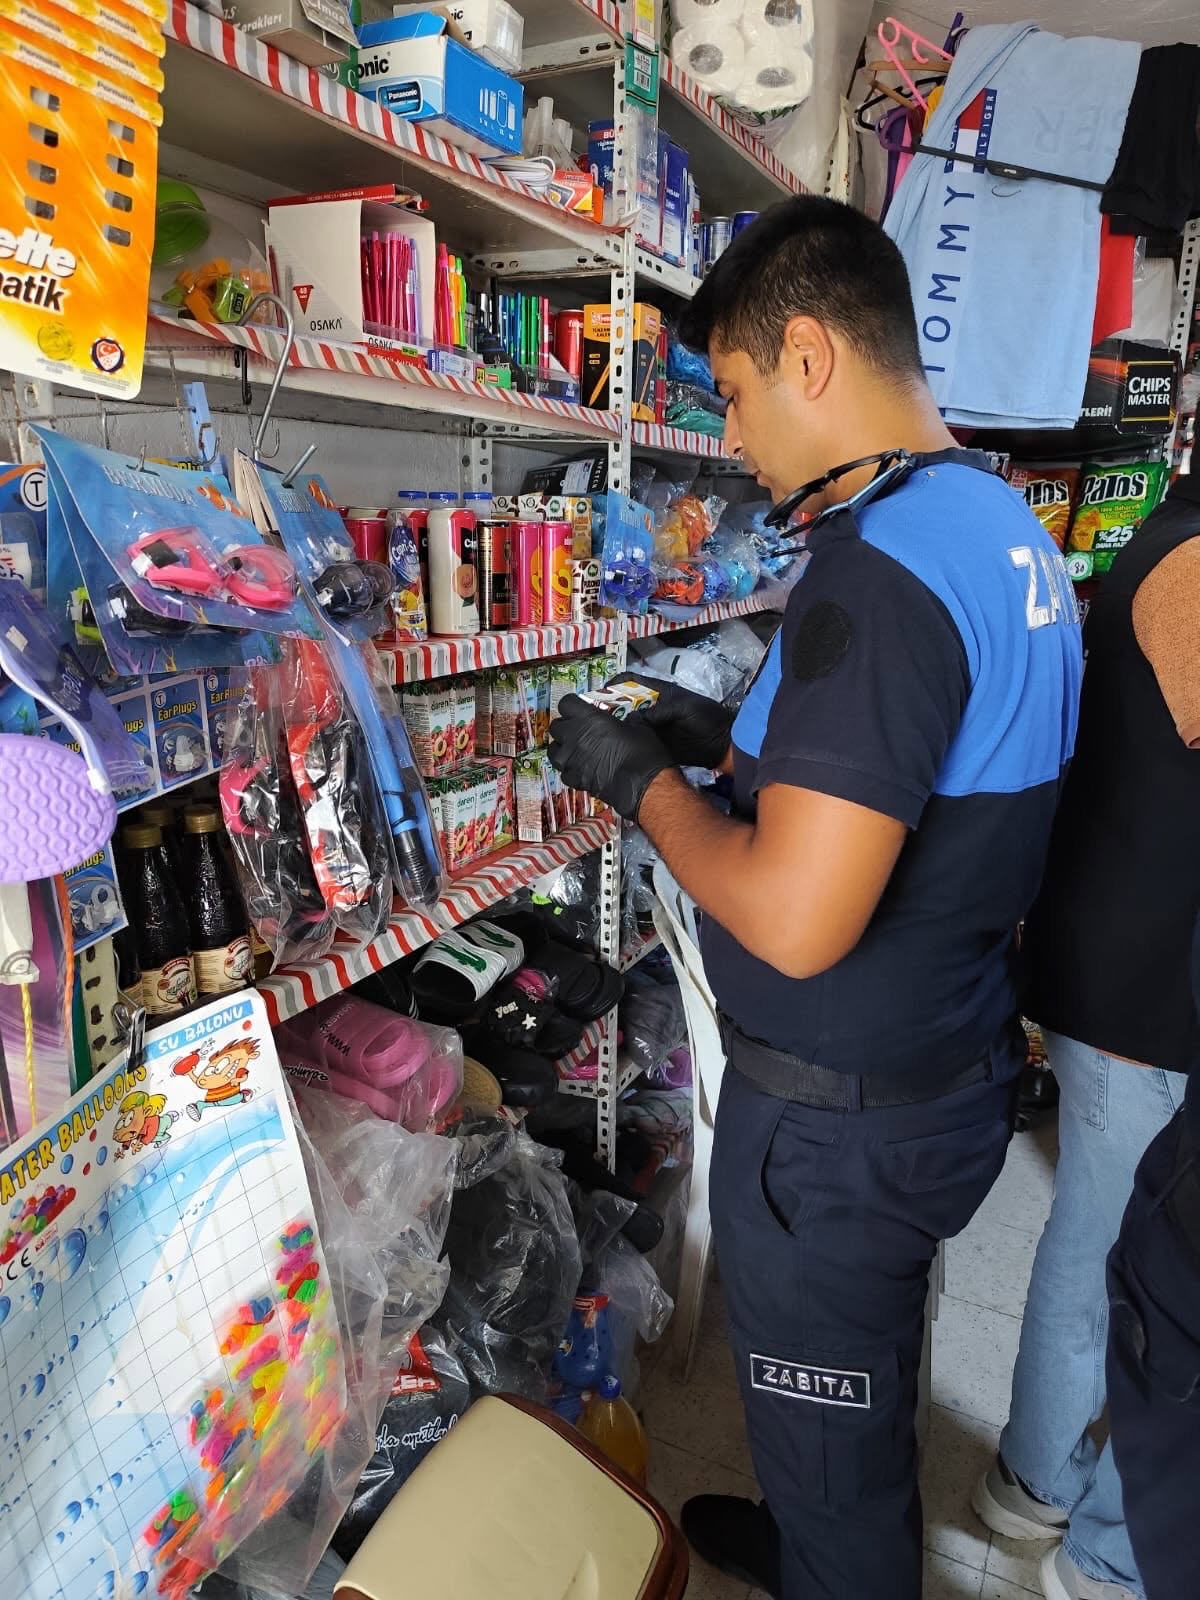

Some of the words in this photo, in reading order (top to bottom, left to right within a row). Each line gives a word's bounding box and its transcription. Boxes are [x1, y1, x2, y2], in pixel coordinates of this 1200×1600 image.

[977, 95, 995, 158] ILFIGER
[0, 269, 65, 312] atik
[1127, 394, 1170, 406] MASTER
[1129, 377, 1171, 394] CHIPS
[495, 1001, 519, 1018] yes!
[158, 1037, 181, 1055] SU
[184, 1006, 244, 1043] BALONU
[0, 1138, 55, 1206] ATER
[762, 1364, 855, 1399] ZABITA
